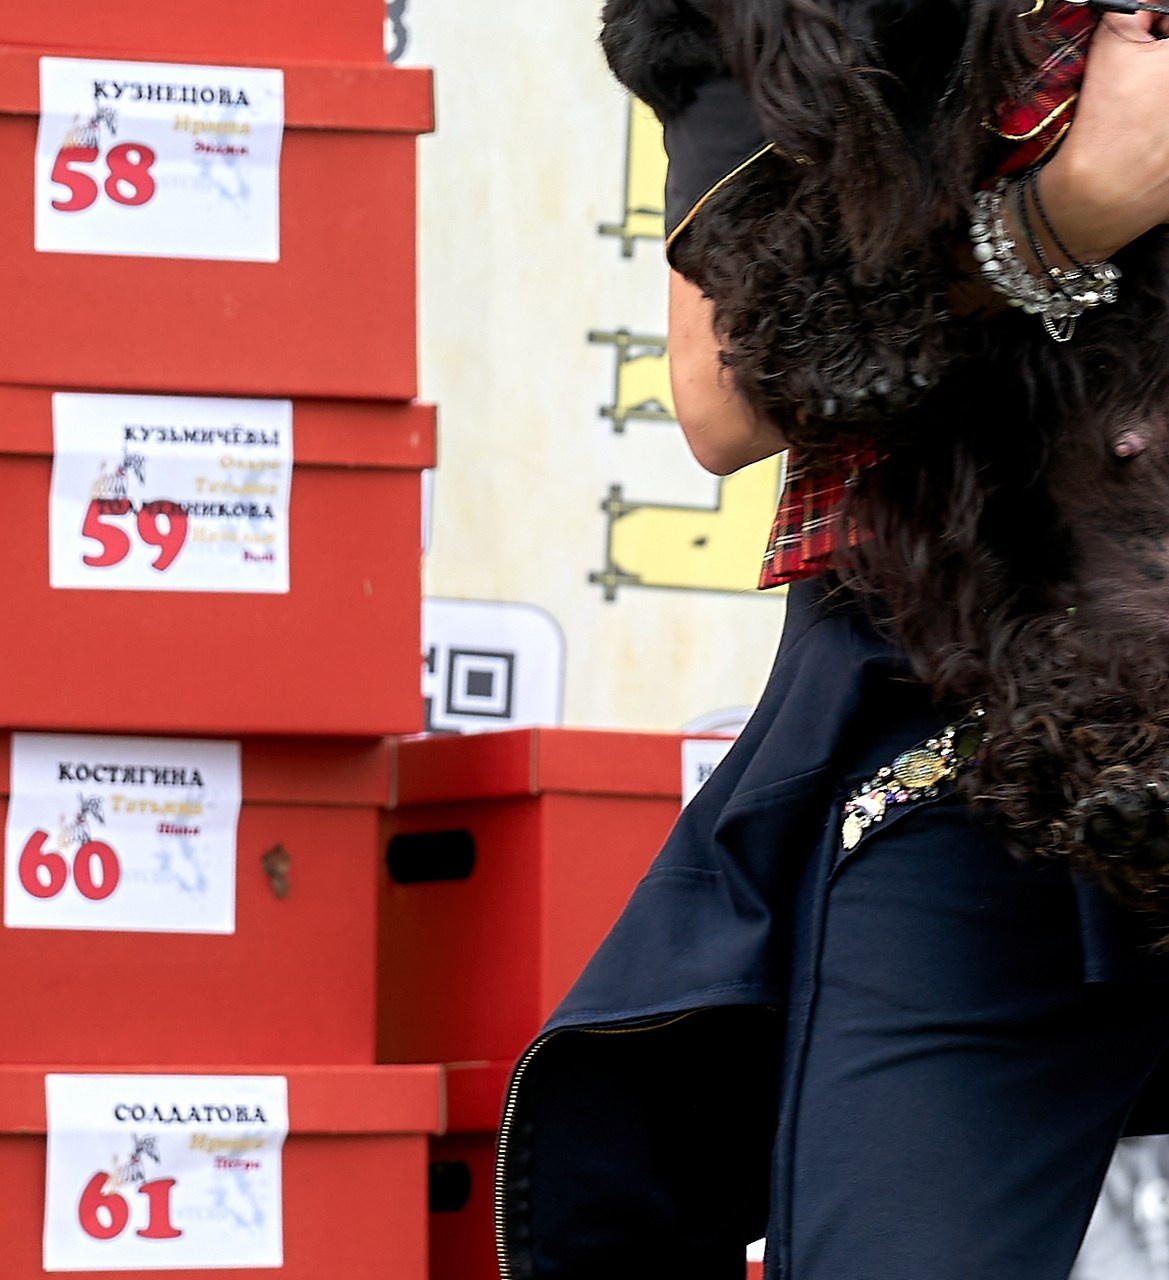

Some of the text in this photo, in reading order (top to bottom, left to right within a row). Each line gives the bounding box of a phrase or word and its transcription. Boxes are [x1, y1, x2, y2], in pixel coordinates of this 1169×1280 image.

[93, 80, 250, 107] КУЗНЕЦОВА
[51, 143, 155, 212] 58
[82, 498, 188, 571] 59
[58, 762, 204, 787] КОСТЯГИНА
[19, 830, 120, 900] 60
[114, 1104, 267, 1123] СОЛДАТОВА
[78, 1171, 182, 1239] 61
